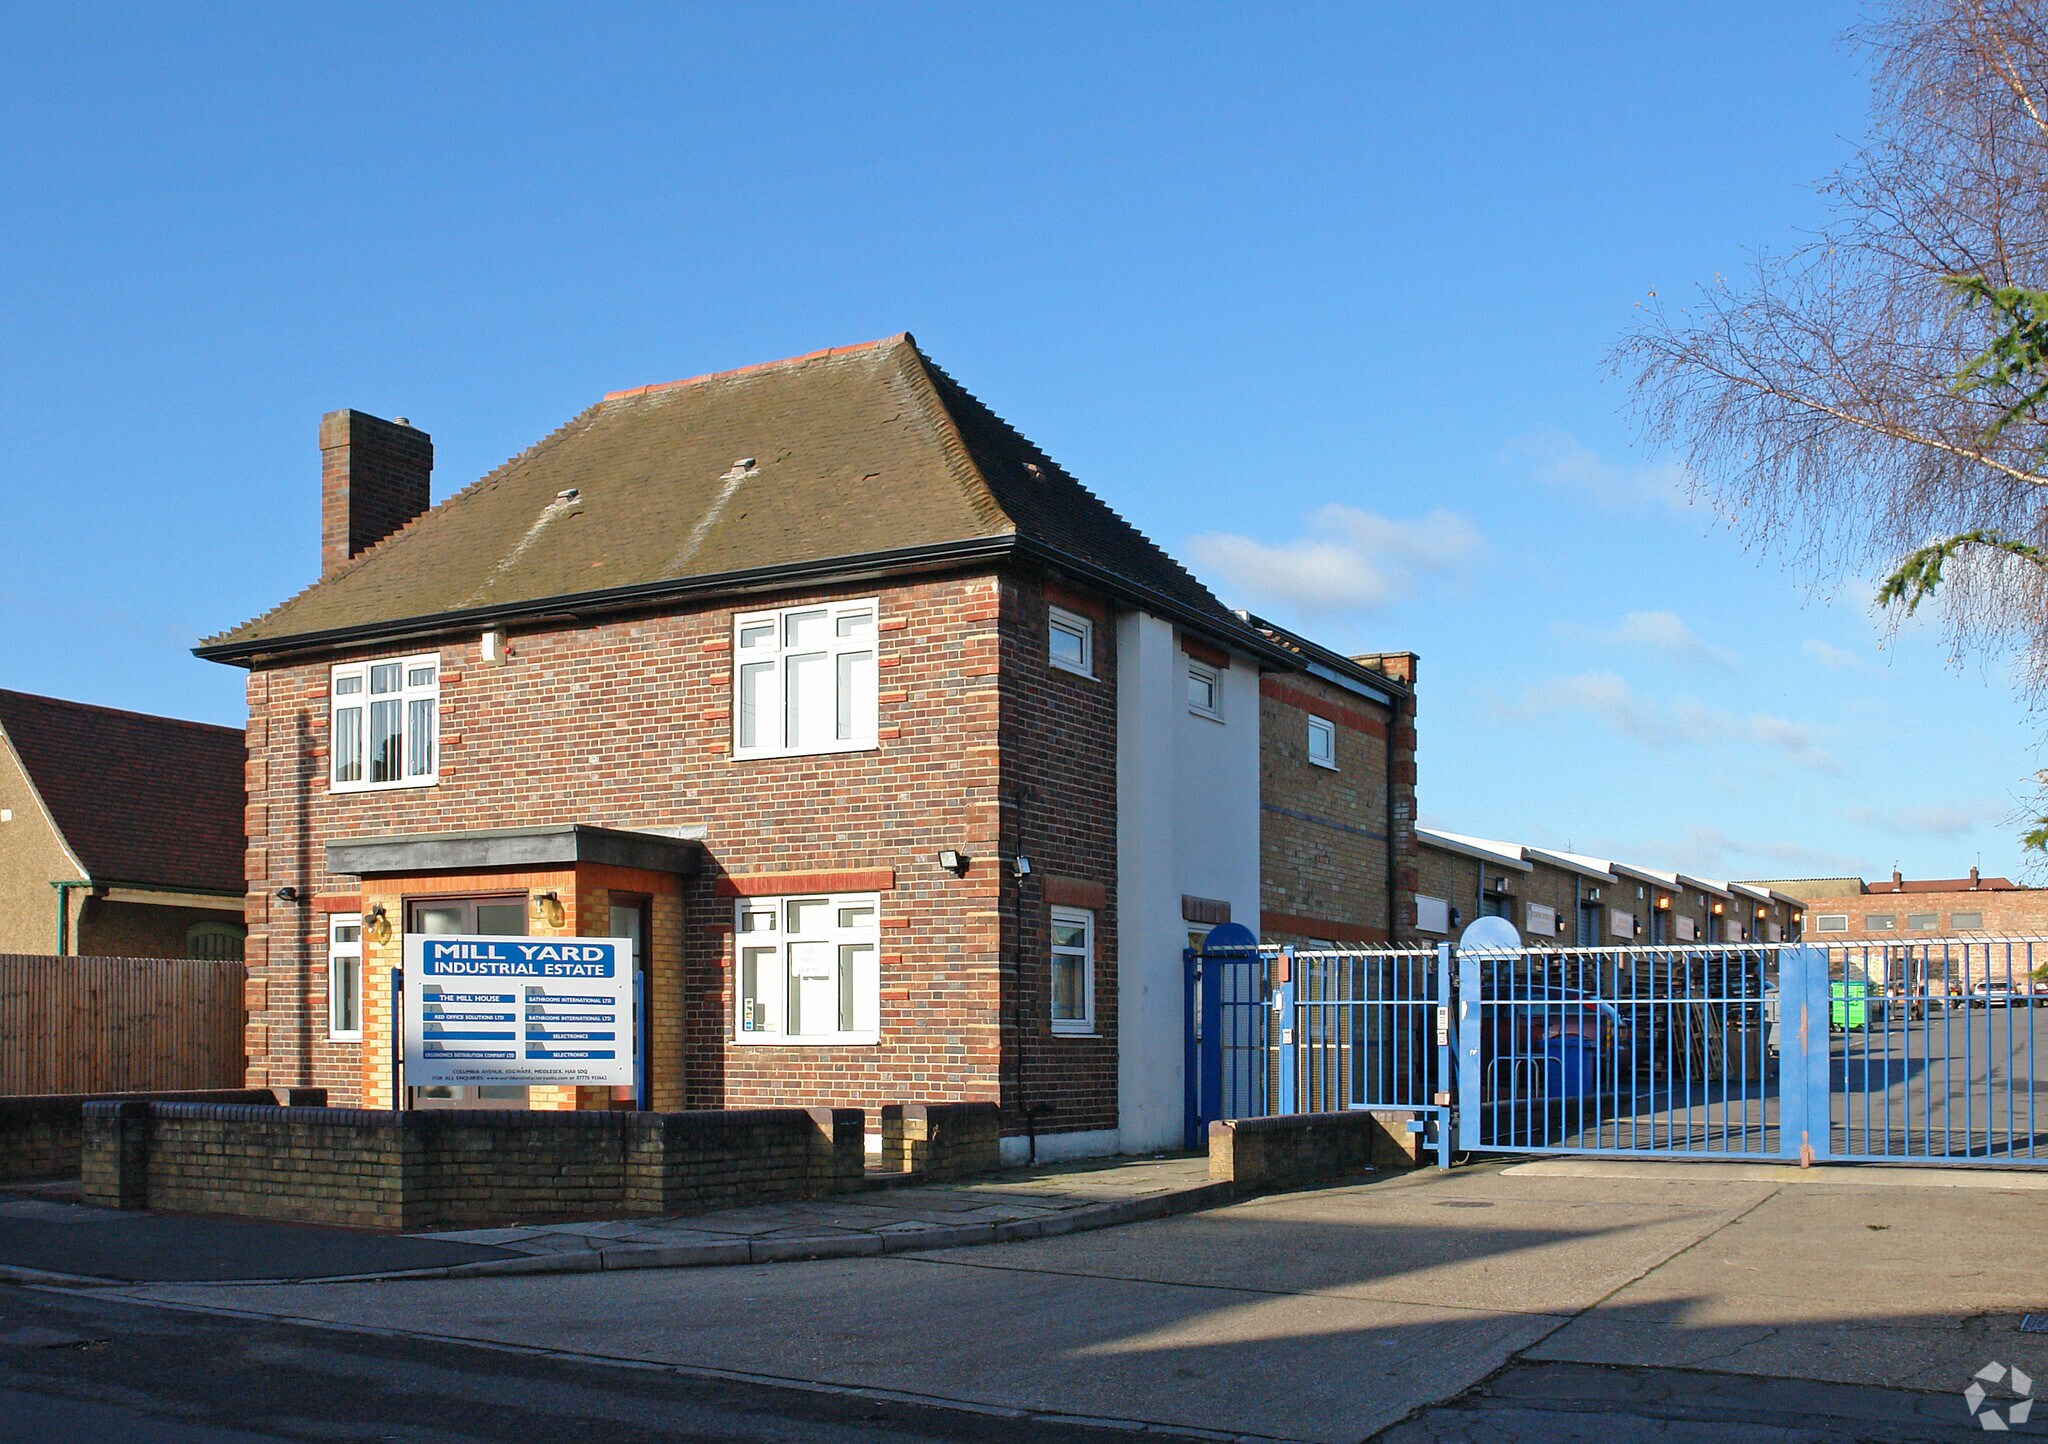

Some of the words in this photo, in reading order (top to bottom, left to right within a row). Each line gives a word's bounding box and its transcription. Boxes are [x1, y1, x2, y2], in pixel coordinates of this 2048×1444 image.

[434, 944, 506, 960] MILL
[517, 945, 604, 961] YARD
[434, 961, 539, 975] INDUSTRIAL
[544, 964, 604, 976] ESTATE
